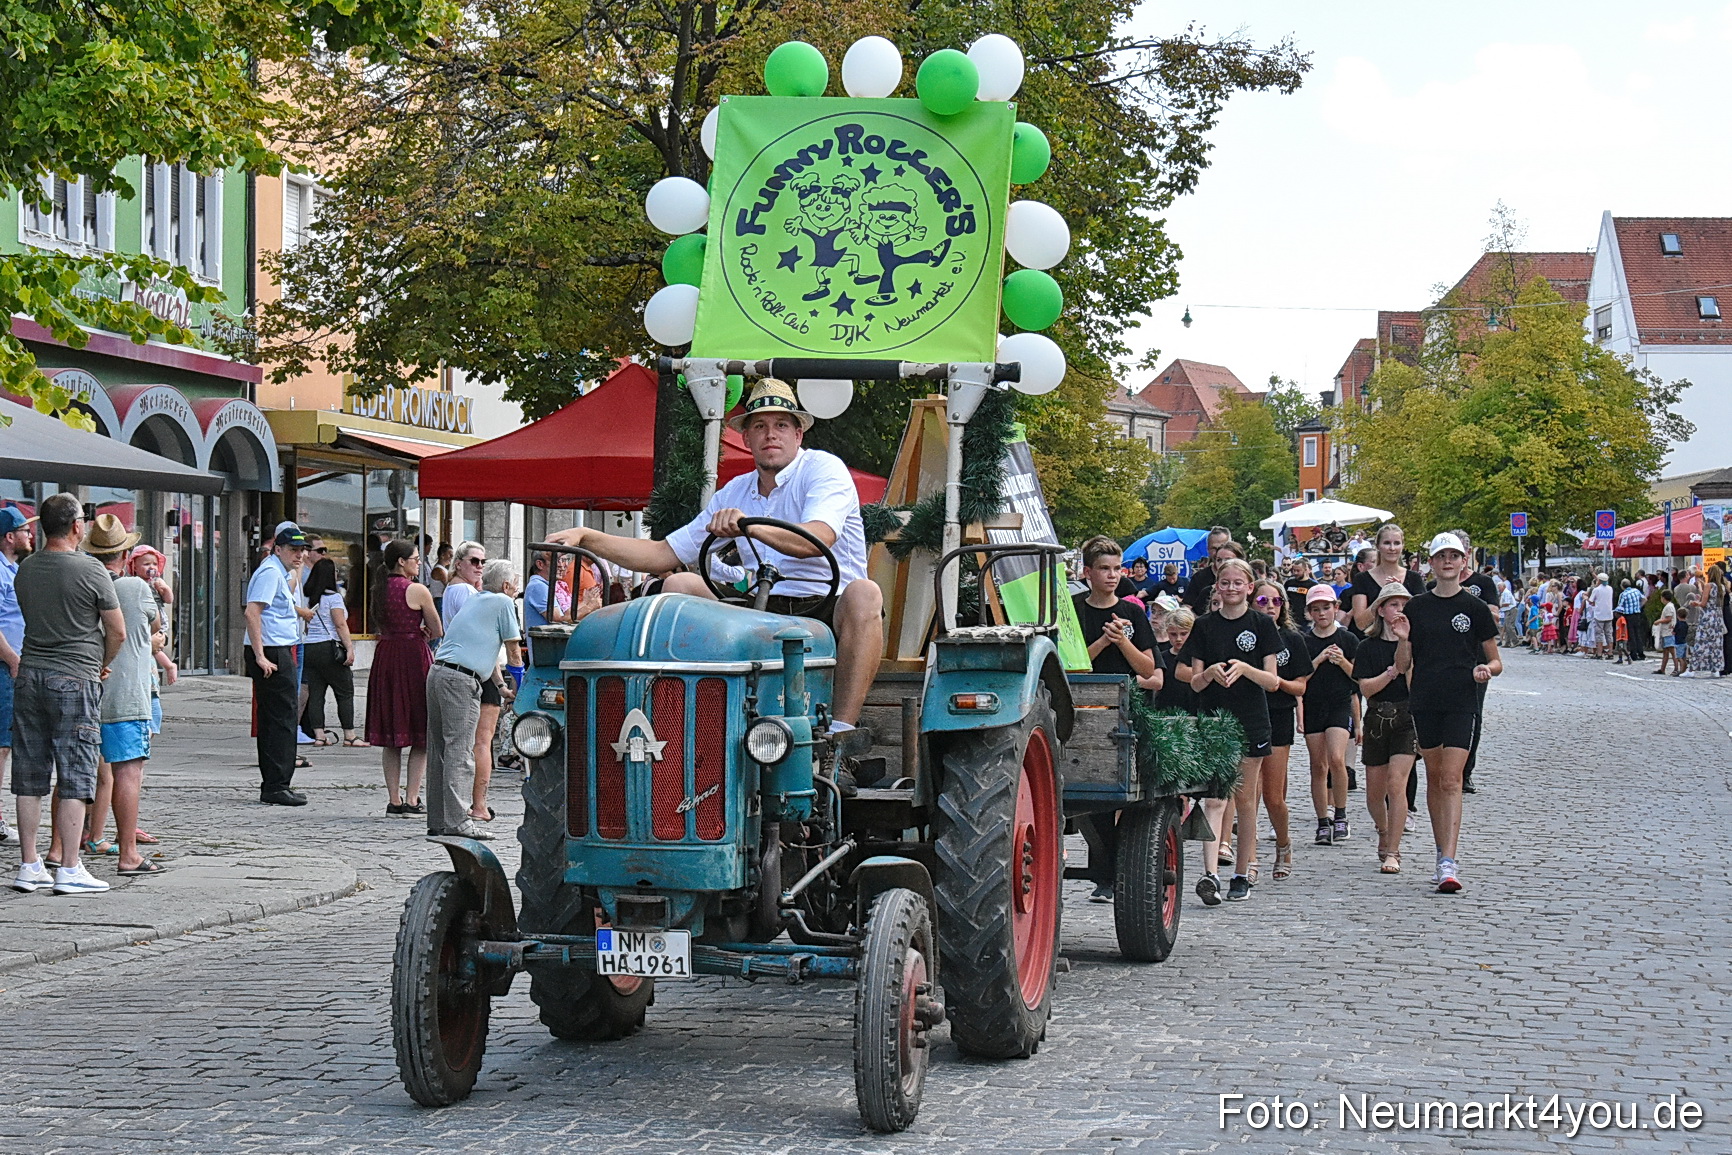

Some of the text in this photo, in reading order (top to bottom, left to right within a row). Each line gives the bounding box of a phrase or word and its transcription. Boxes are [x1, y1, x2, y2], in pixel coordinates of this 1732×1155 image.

[829, 324, 871, 346] DJK
[884, 282, 954, 333] Neumarkt
[1158, 547, 1174, 559] SV
[1149, 561, 1185, 575] STAF
[602, 942, 608, 950] D
[619, 932, 646, 953] NM
